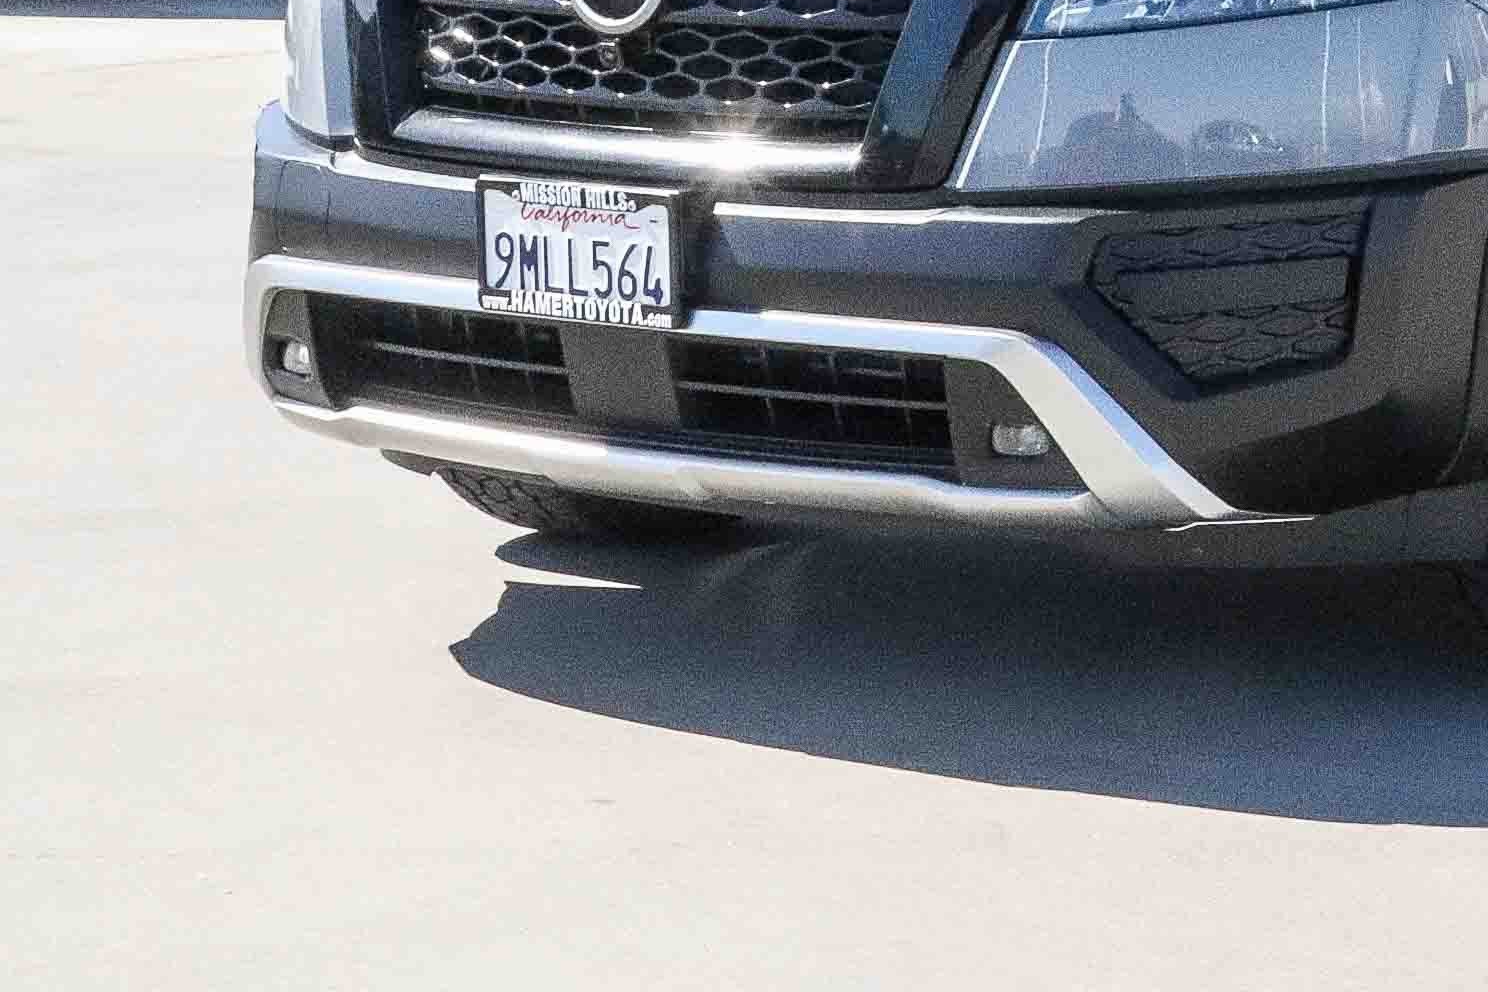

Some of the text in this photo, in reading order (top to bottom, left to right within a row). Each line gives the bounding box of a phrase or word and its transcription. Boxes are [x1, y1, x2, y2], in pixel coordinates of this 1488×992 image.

[519, 182, 628, 211] MISSION HILLS
[520, 205, 641, 232] California
[494, 231, 665, 305] 9MLL564
[481, 289, 673, 329] www.HAMERTOYOTA.com
